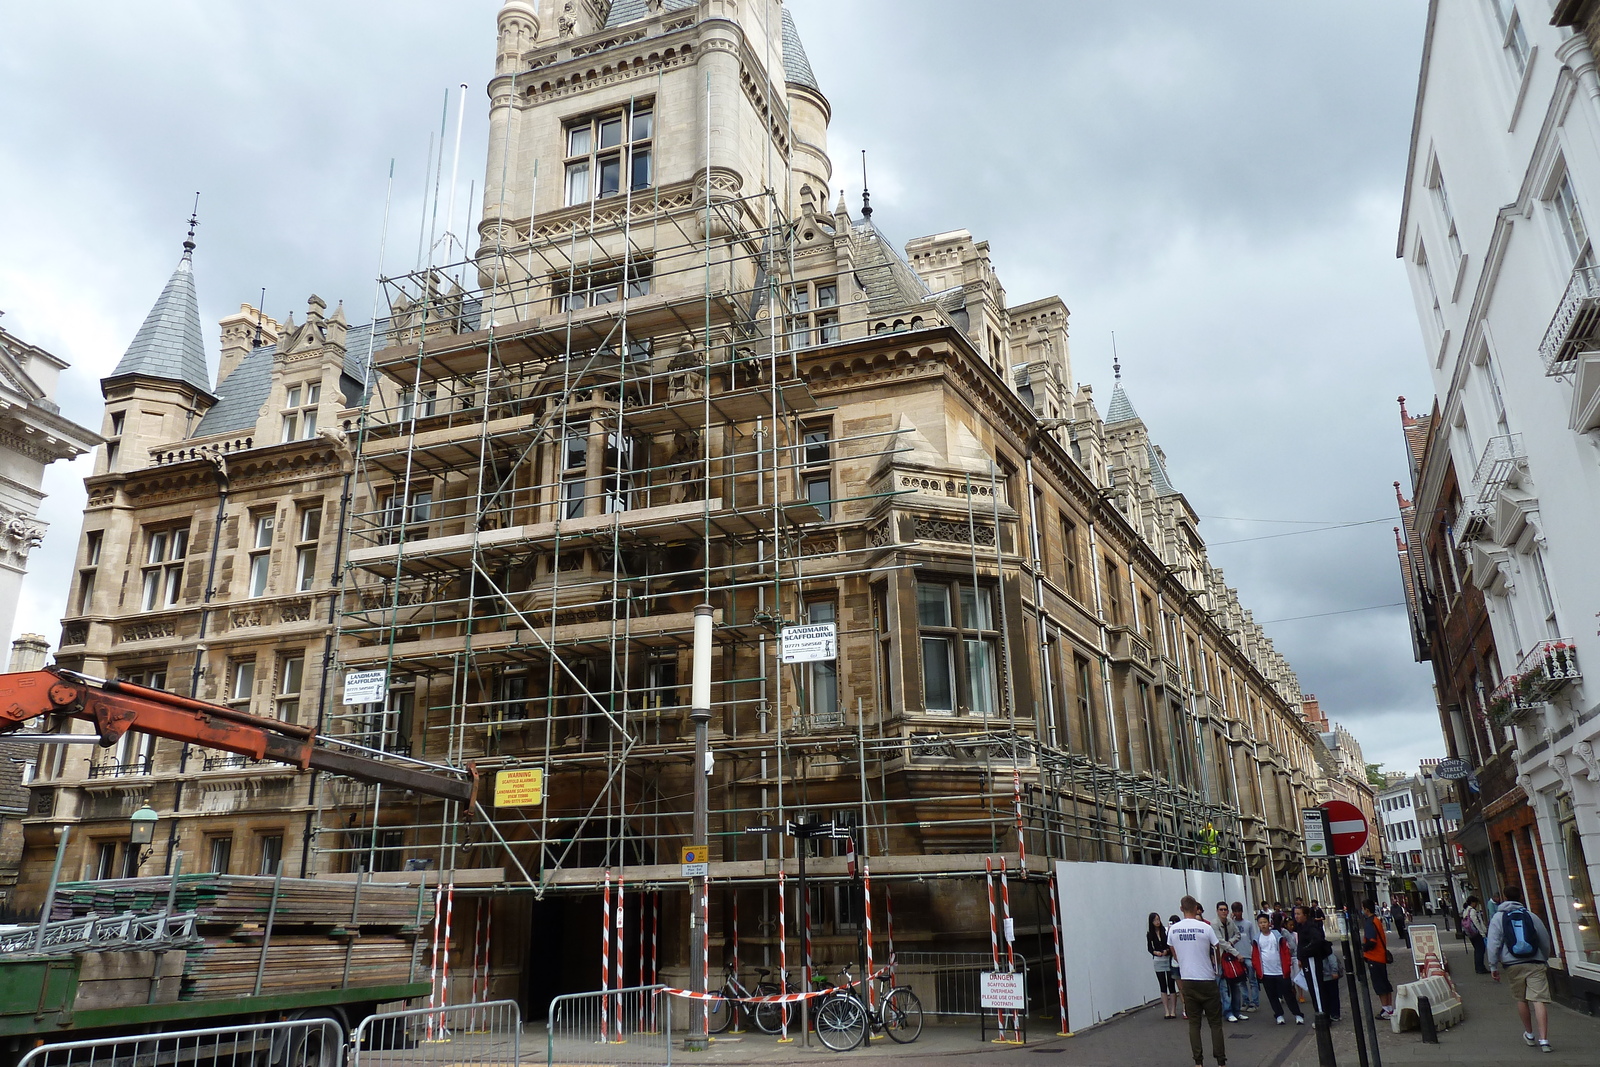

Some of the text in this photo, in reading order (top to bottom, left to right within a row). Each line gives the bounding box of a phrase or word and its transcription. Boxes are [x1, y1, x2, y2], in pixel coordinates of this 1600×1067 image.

[788, 626, 829, 634] LANDMARK
[785, 632, 833, 640] SCAFFOLDING
[348, 677, 383, 685] SCAFFOLDING
[1440, 770, 1468, 778] SURGERY
